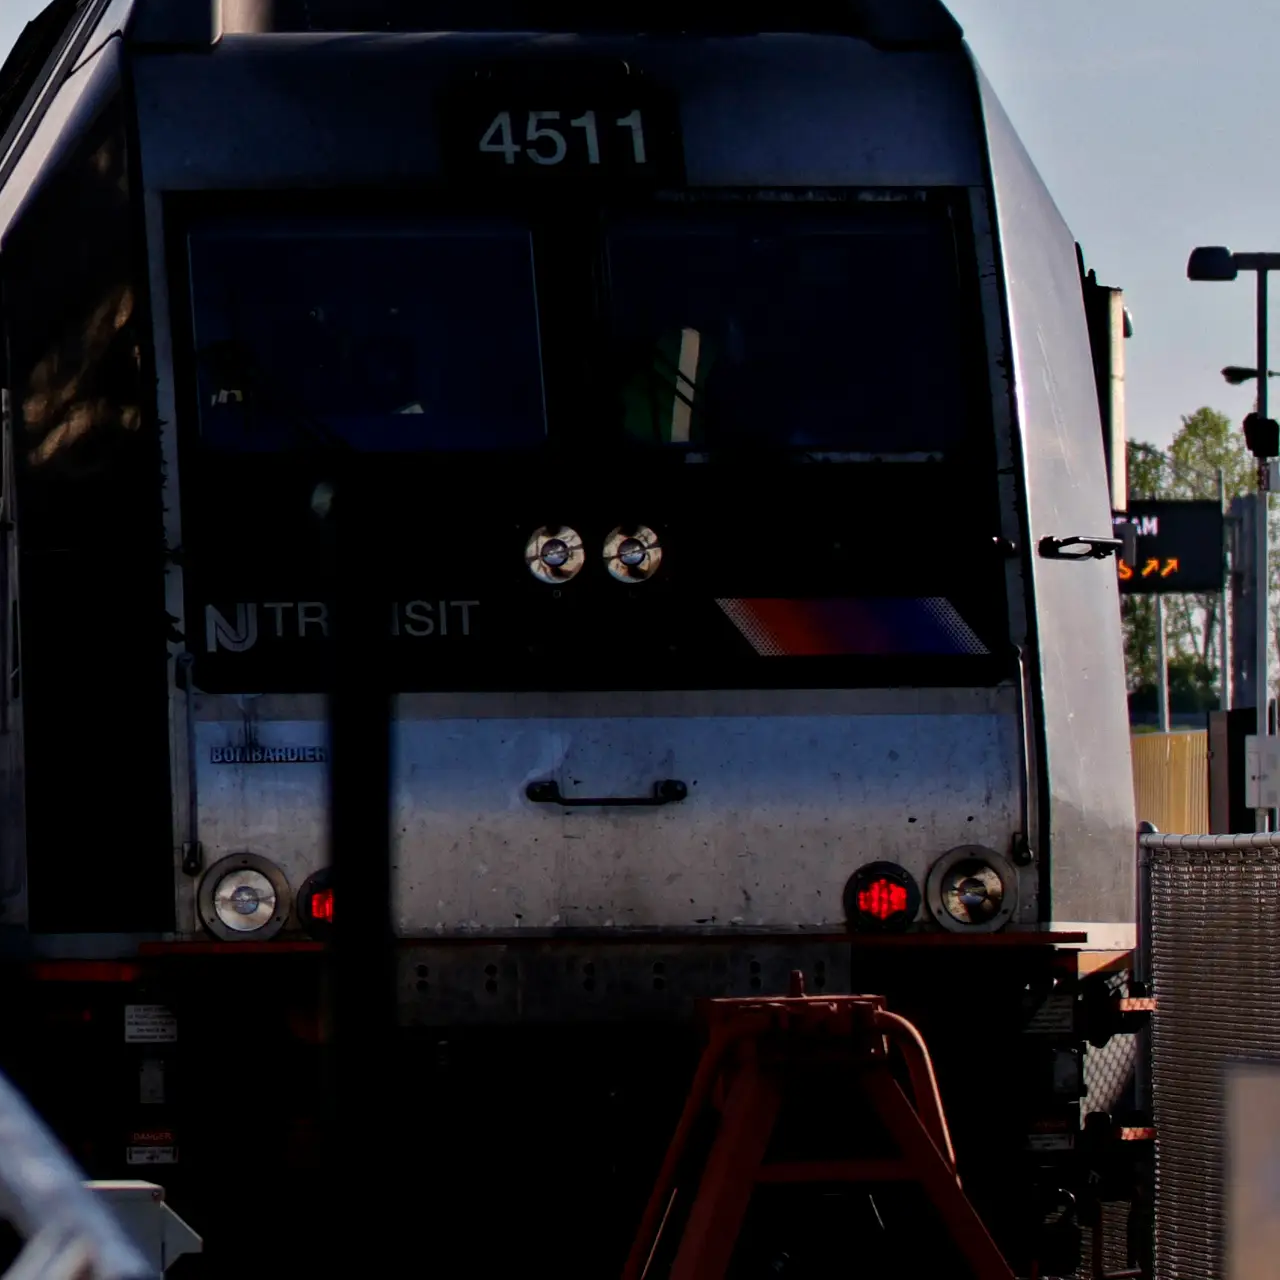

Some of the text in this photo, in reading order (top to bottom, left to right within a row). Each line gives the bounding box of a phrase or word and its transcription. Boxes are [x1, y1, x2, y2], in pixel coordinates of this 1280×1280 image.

[479, 110, 647, 166] 4511
[204, 600, 480, 654] NJ TRSIT
[212, 746, 327, 762] BOMBARDIER
